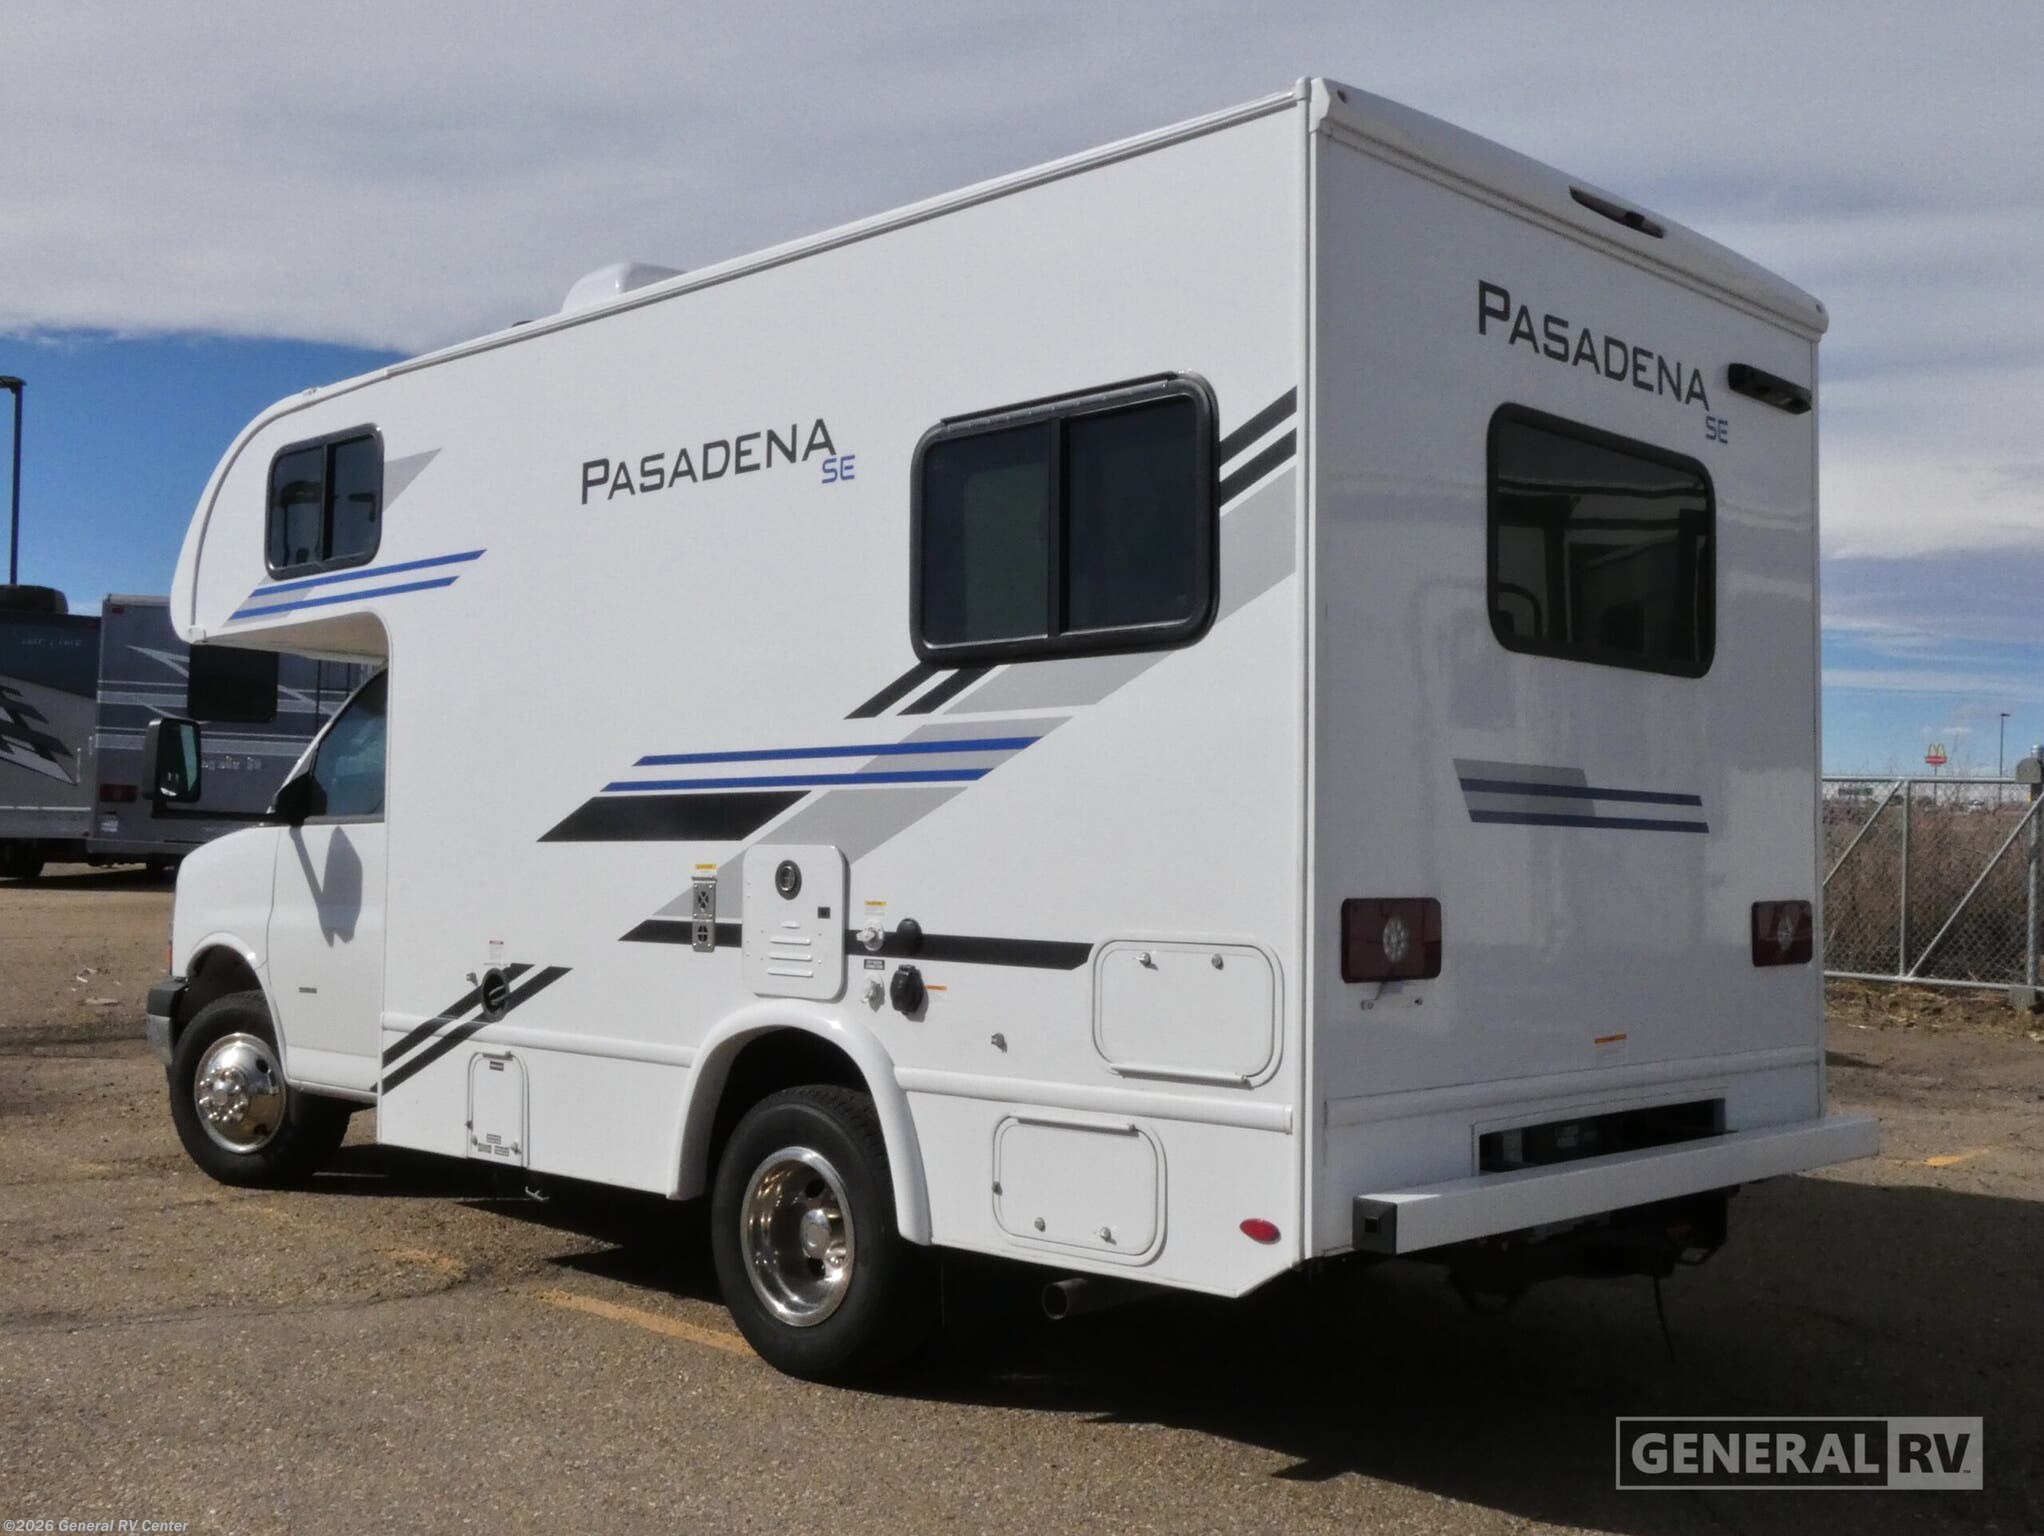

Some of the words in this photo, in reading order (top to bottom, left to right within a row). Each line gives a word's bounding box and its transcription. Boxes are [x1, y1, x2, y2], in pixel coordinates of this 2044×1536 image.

[1478, 280, 1710, 411] PASADENA
[1705, 416, 1728, 444] SE
[581, 418, 837, 505] PASADENA
[821, 454, 856, 484] SE
